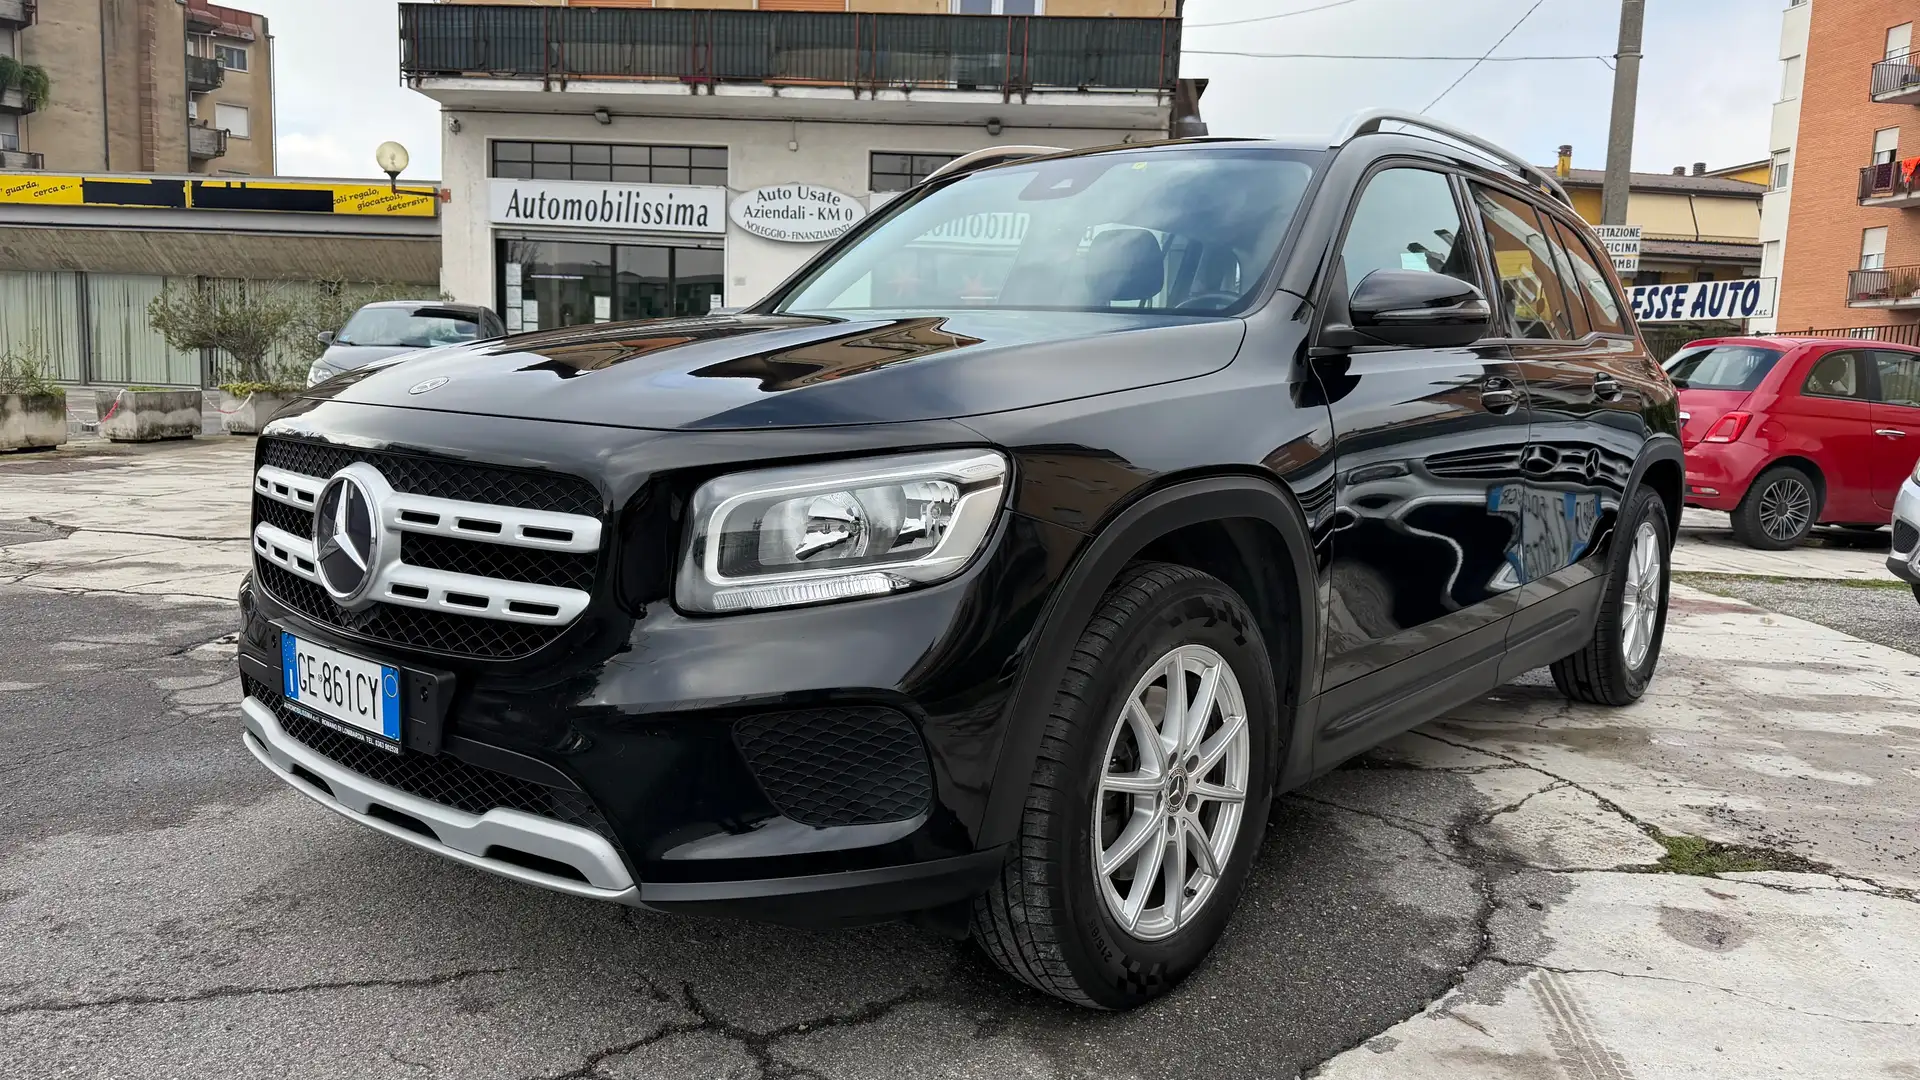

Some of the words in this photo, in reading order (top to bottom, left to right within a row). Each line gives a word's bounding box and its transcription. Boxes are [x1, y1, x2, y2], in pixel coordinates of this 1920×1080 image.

[5, 181, 39, 196] guarda,
[34, 186, 58, 197] cerca
[349, 187, 379, 200] regalo,
[757, 188, 792, 204] Auto
[797, 186, 841, 206] Usate
[357, 193, 403, 211] giocattoli,
[386, 197, 429, 212] detersivi
[506, 188, 709, 227] Automobilissima
[743, 205, 806, 220] Aziendali
[817, 207, 841, 221] KM
[845, 208, 853, 221] 0
[745, 220, 786, 239] NOLEGGIO
[791, 223, 850, 240] FINANZIAMENTI
[1594, 228, 1640, 238] ETTAZIONE
[1613, 259, 1636, 269] AMBI
[1624, 285, 1688, 320] ESSE
[1690, 280, 1760, 318] AUTO
